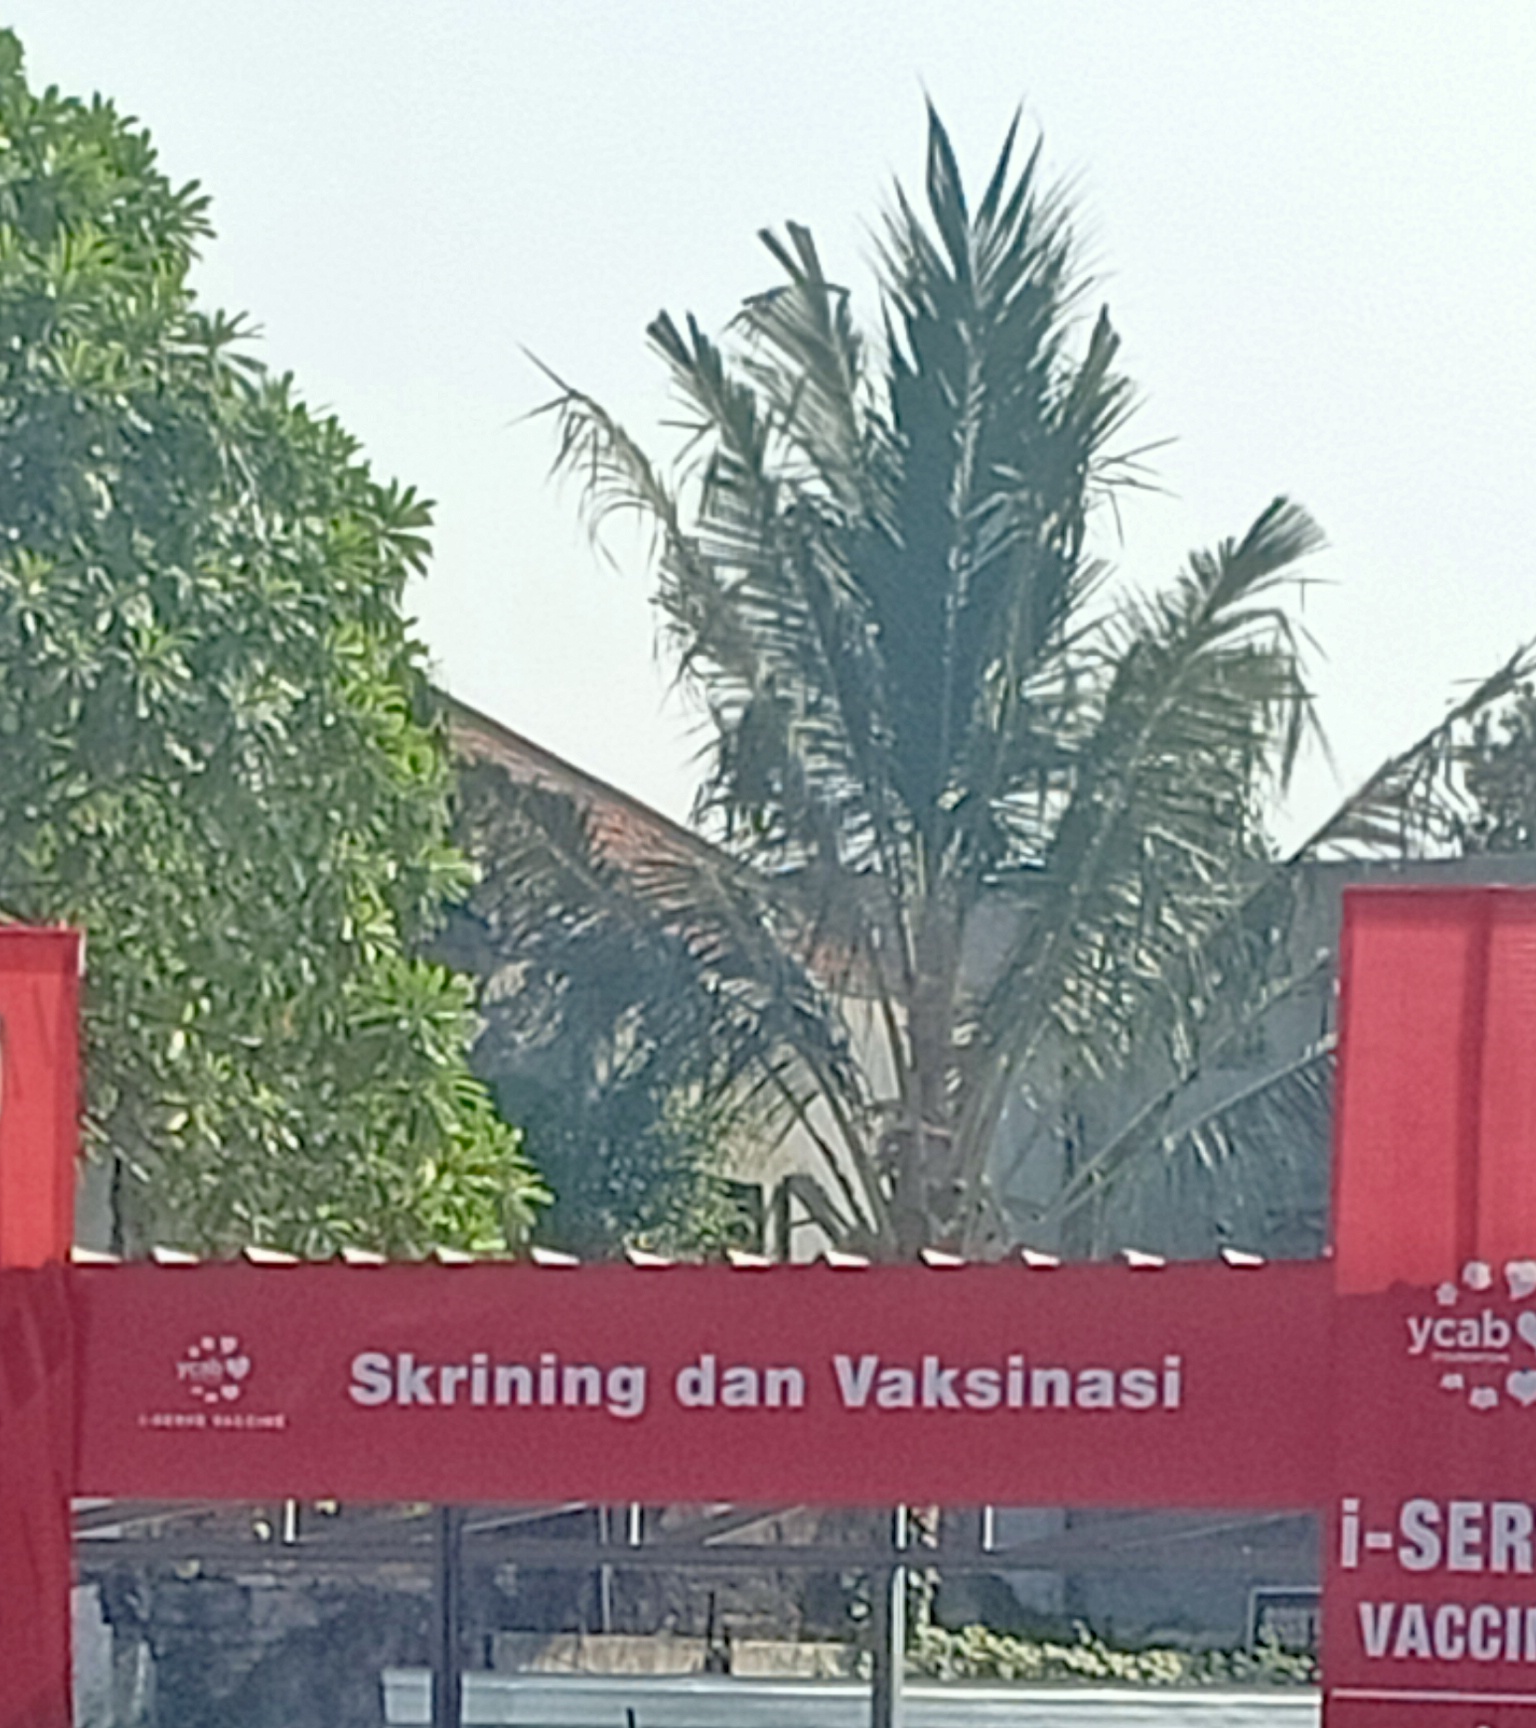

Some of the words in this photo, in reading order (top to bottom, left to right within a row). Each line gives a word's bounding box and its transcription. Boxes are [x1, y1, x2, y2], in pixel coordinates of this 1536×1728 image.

[1407, 1308, 1512, 1355] ycab
[349, 1351, 646, 1418] Skrining
[675, 1353, 805, 1408] dan
[833, 1354, 1181, 1409] Vaksinasi
